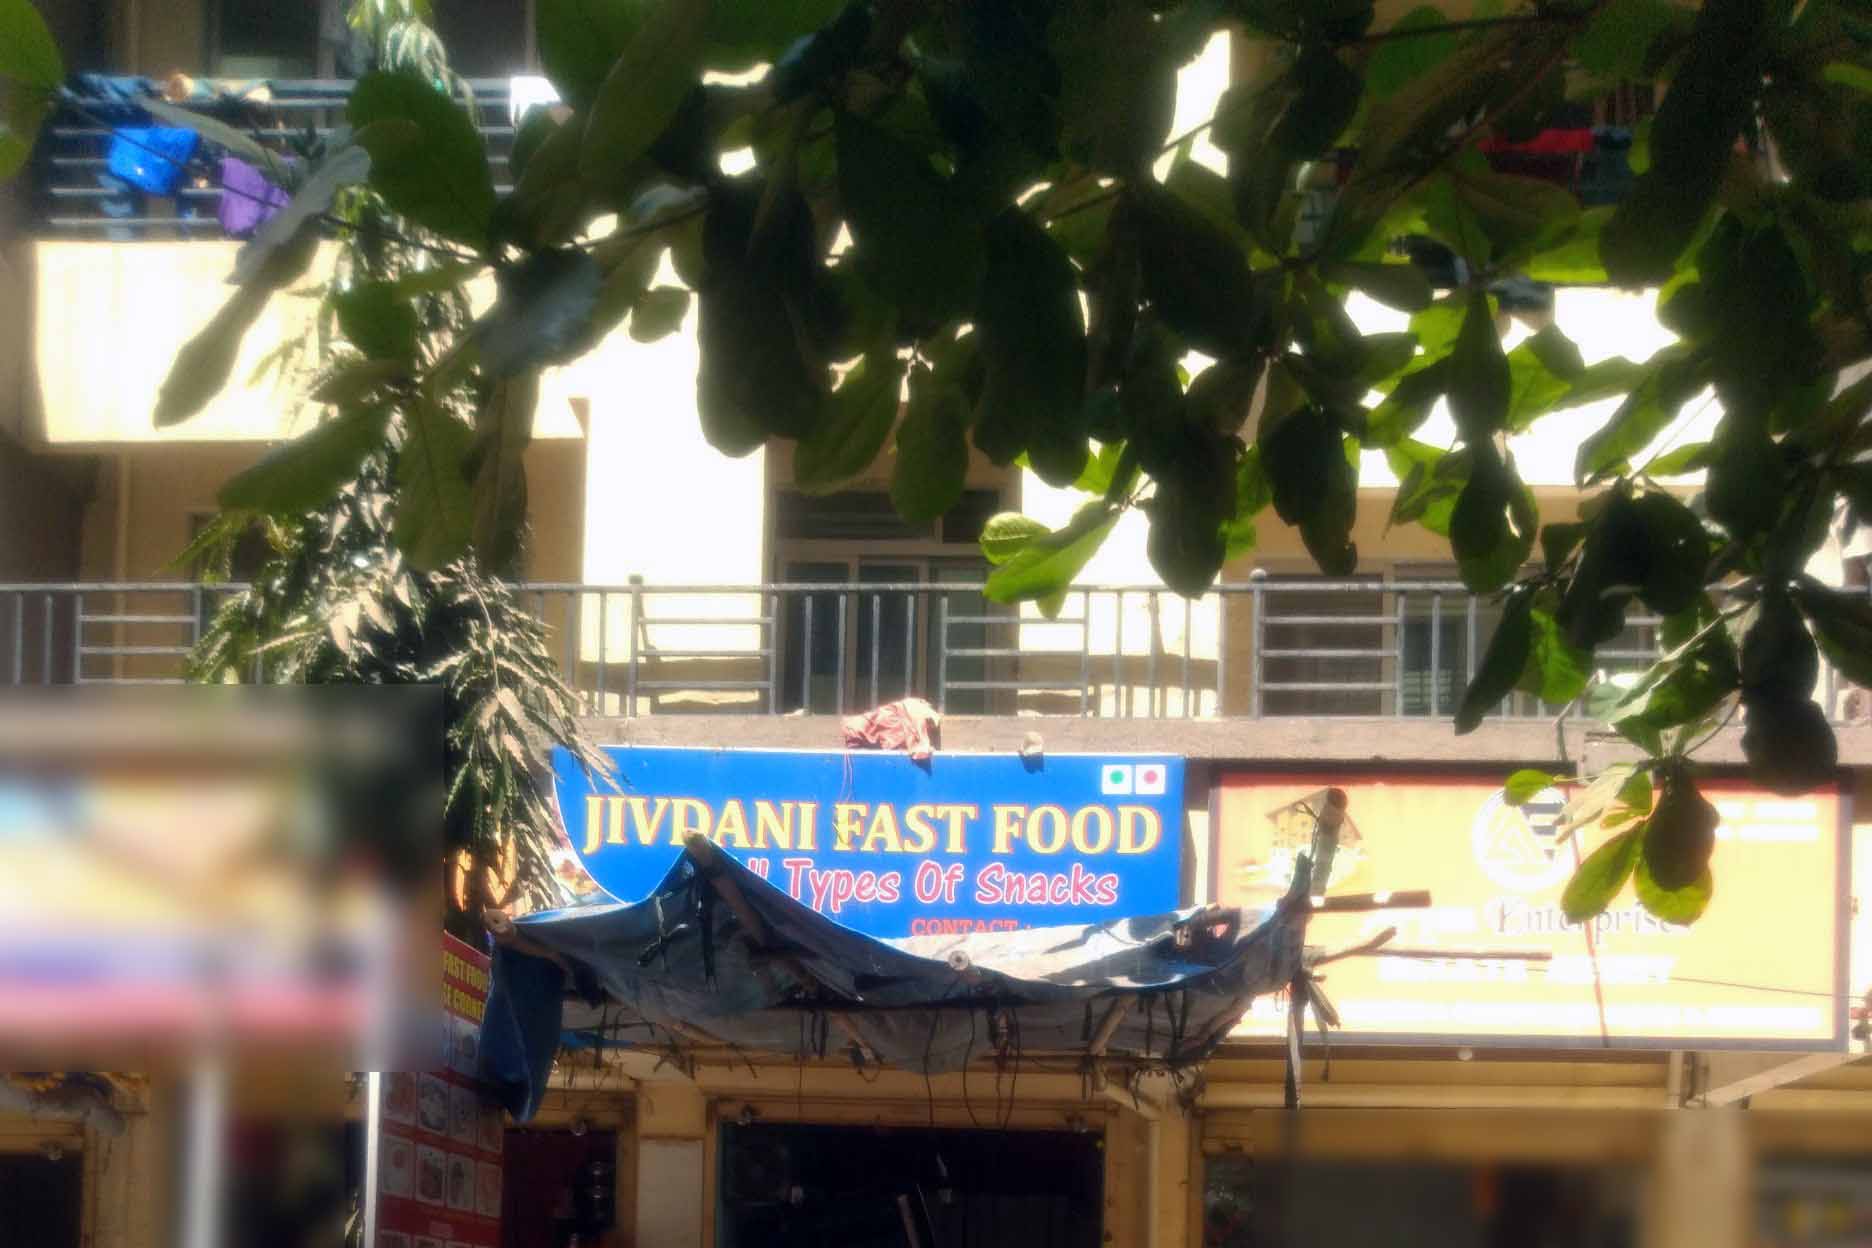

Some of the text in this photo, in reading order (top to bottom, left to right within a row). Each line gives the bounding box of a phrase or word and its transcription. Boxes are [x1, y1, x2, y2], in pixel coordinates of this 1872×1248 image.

[583, 795, 1162, 857] JIVDANI FAST FOOD
[784, 858, 901, 913] Types
[913, 859, 965, 905] Of
[976, 863, 1120, 905] Snacks
